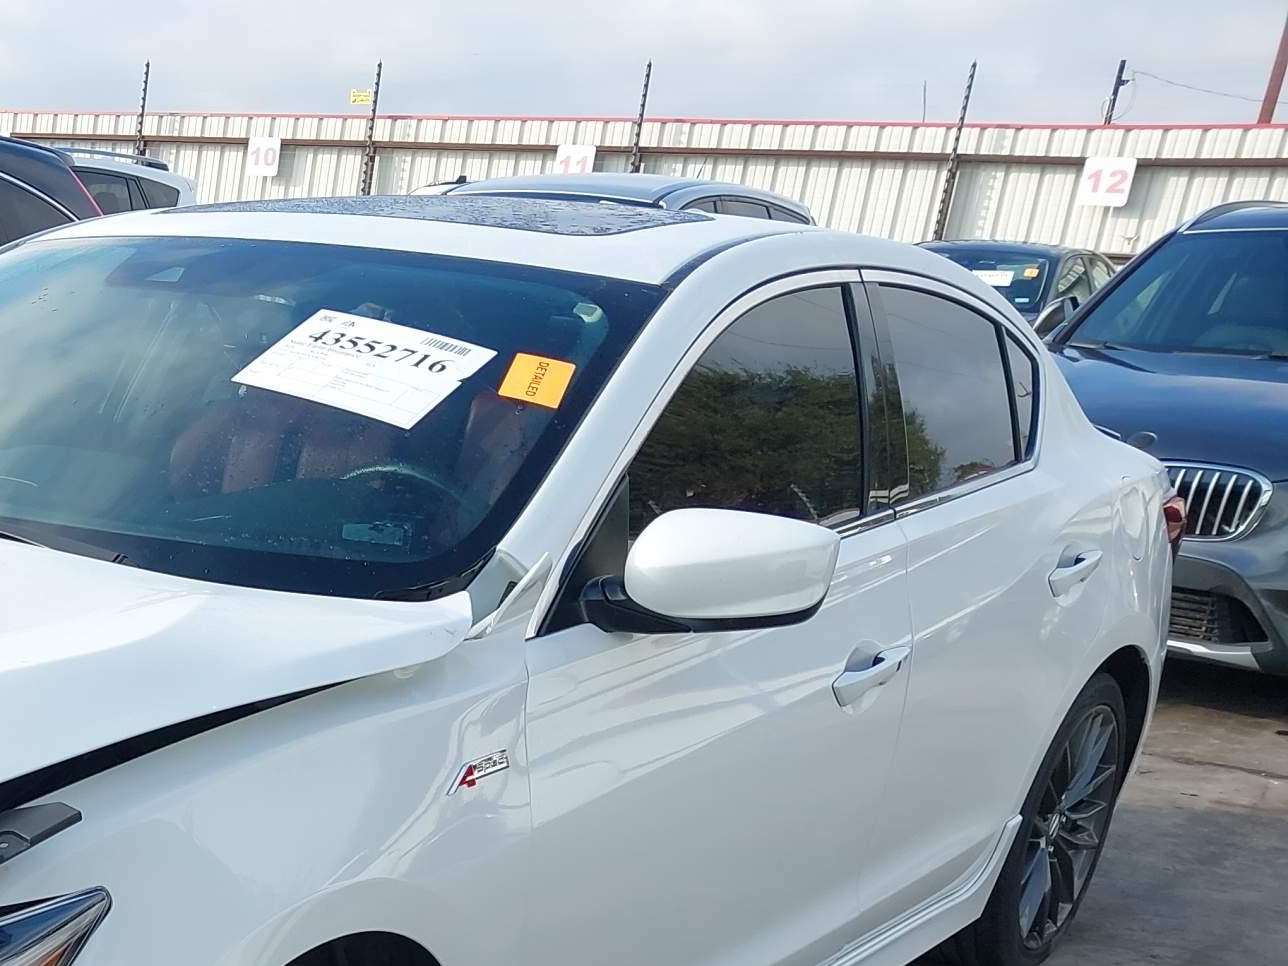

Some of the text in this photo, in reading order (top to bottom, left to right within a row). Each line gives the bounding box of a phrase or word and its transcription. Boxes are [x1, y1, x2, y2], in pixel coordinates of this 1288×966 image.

[250, 146, 277, 167] 10
[559, 155, 589, 177] 11
[1087, 168, 1130, 193] 12
[308, 329, 456, 374] 43552716
[525, 361, 550, 397] DETAILED
